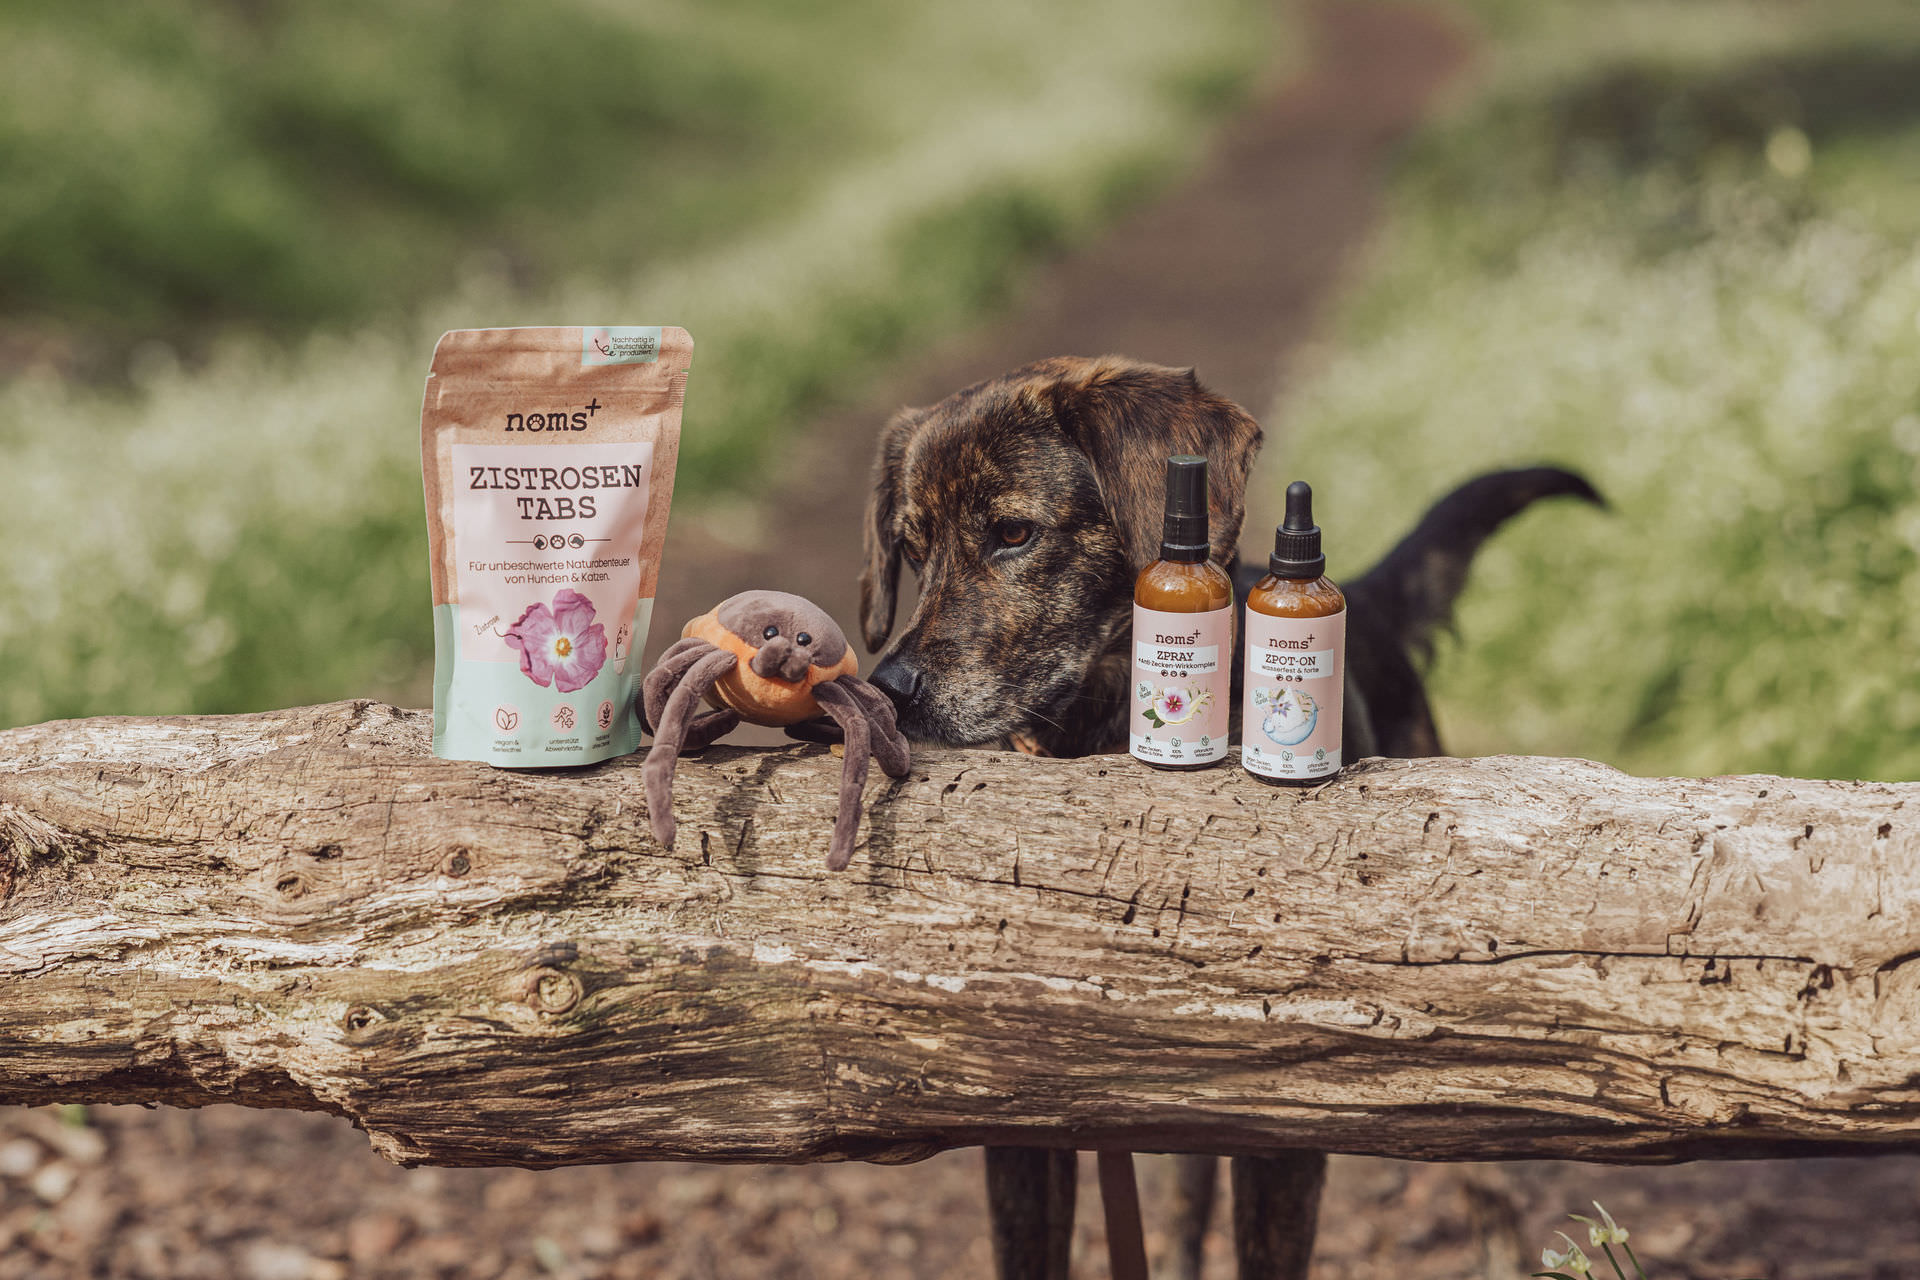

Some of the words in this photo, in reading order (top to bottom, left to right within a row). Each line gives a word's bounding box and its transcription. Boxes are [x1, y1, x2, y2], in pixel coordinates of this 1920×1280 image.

[469, 464, 642, 490] ZISTROSEN
[517, 496, 597, 520] TABS
[469, 561, 487, 571] Für
[489, 560, 564, 571] unbeschwerte
[566, 558, 630, 569] Naturabenteuer
[504, 575, 525, 584] von
[528, 573, 569, 584] Hunden
[571, 573, 580, 582] &
[1157, 650, 1194, 662] ZPRAY
[1265, 654, 1316, 666] ZPOT-ON
